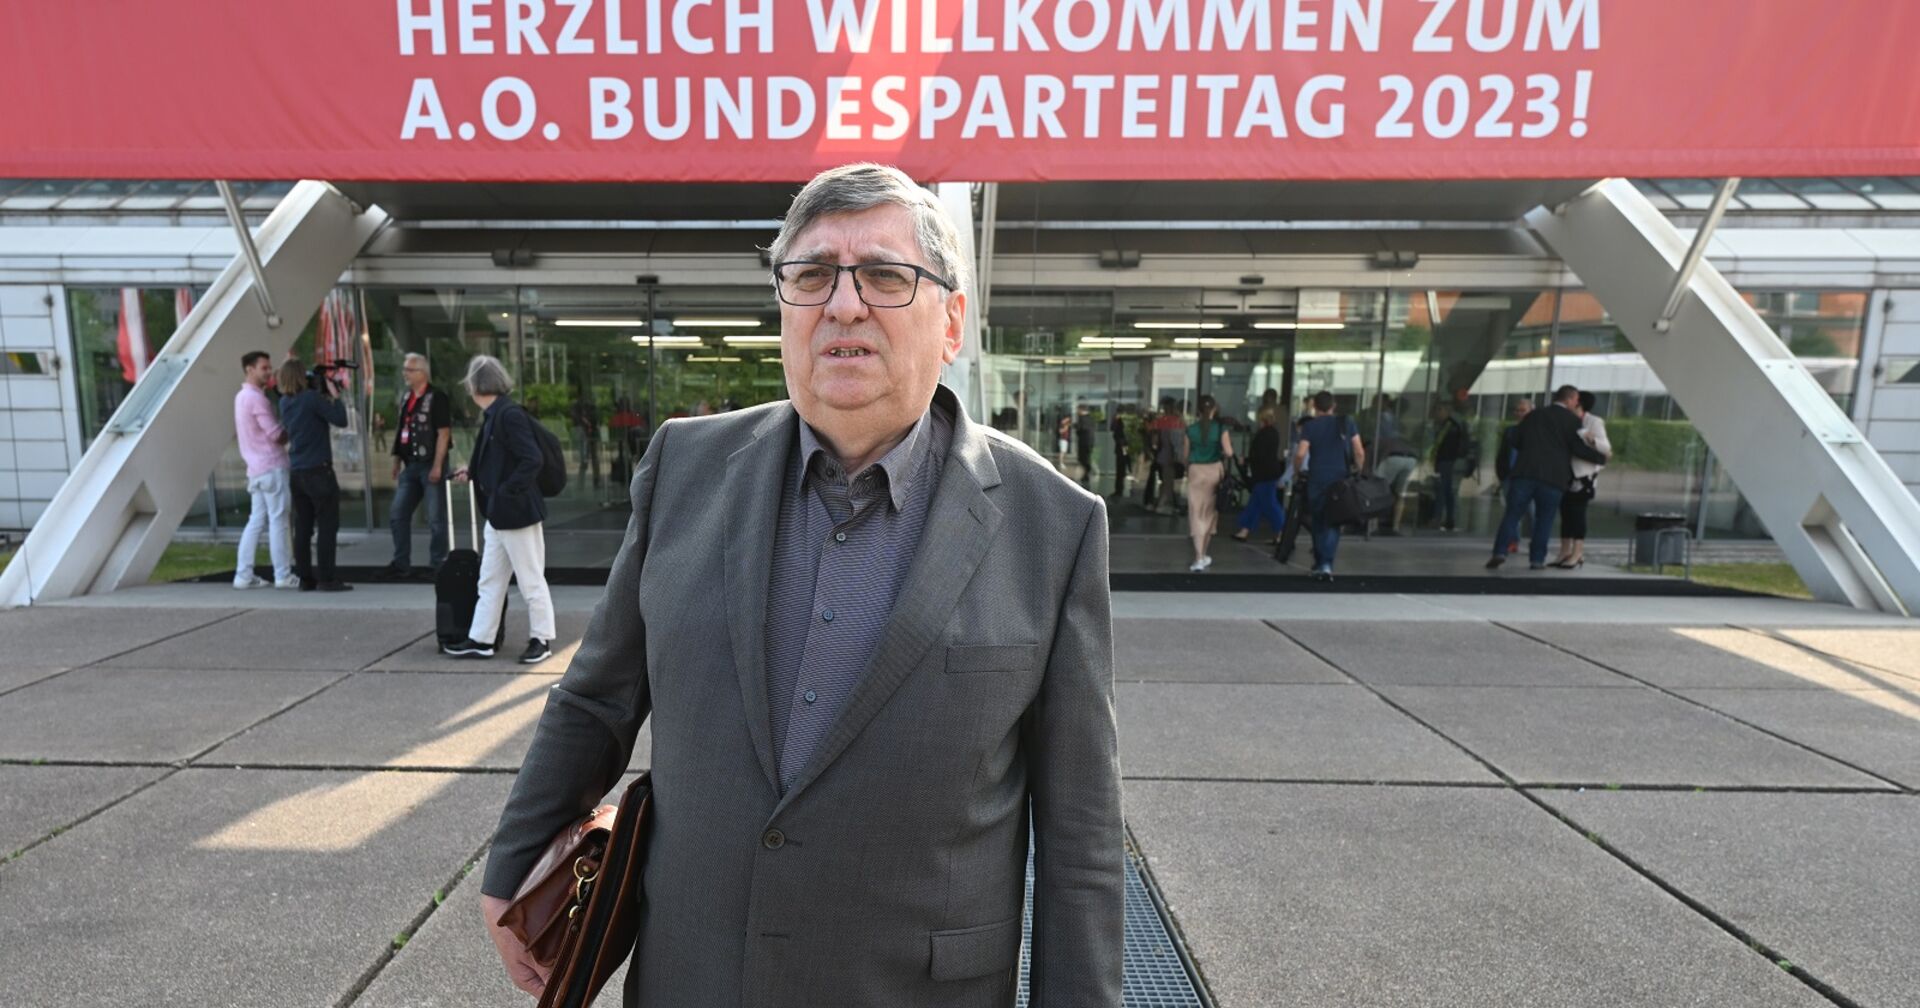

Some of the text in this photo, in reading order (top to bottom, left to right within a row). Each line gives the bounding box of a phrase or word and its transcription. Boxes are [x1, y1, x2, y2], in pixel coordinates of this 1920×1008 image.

[398, 0, 1600, 55] HERZLICH WILLKOMMEN ZUM
[399, 70, 1593, 140] A.O. BUNDESPARTEITAG 2023!
